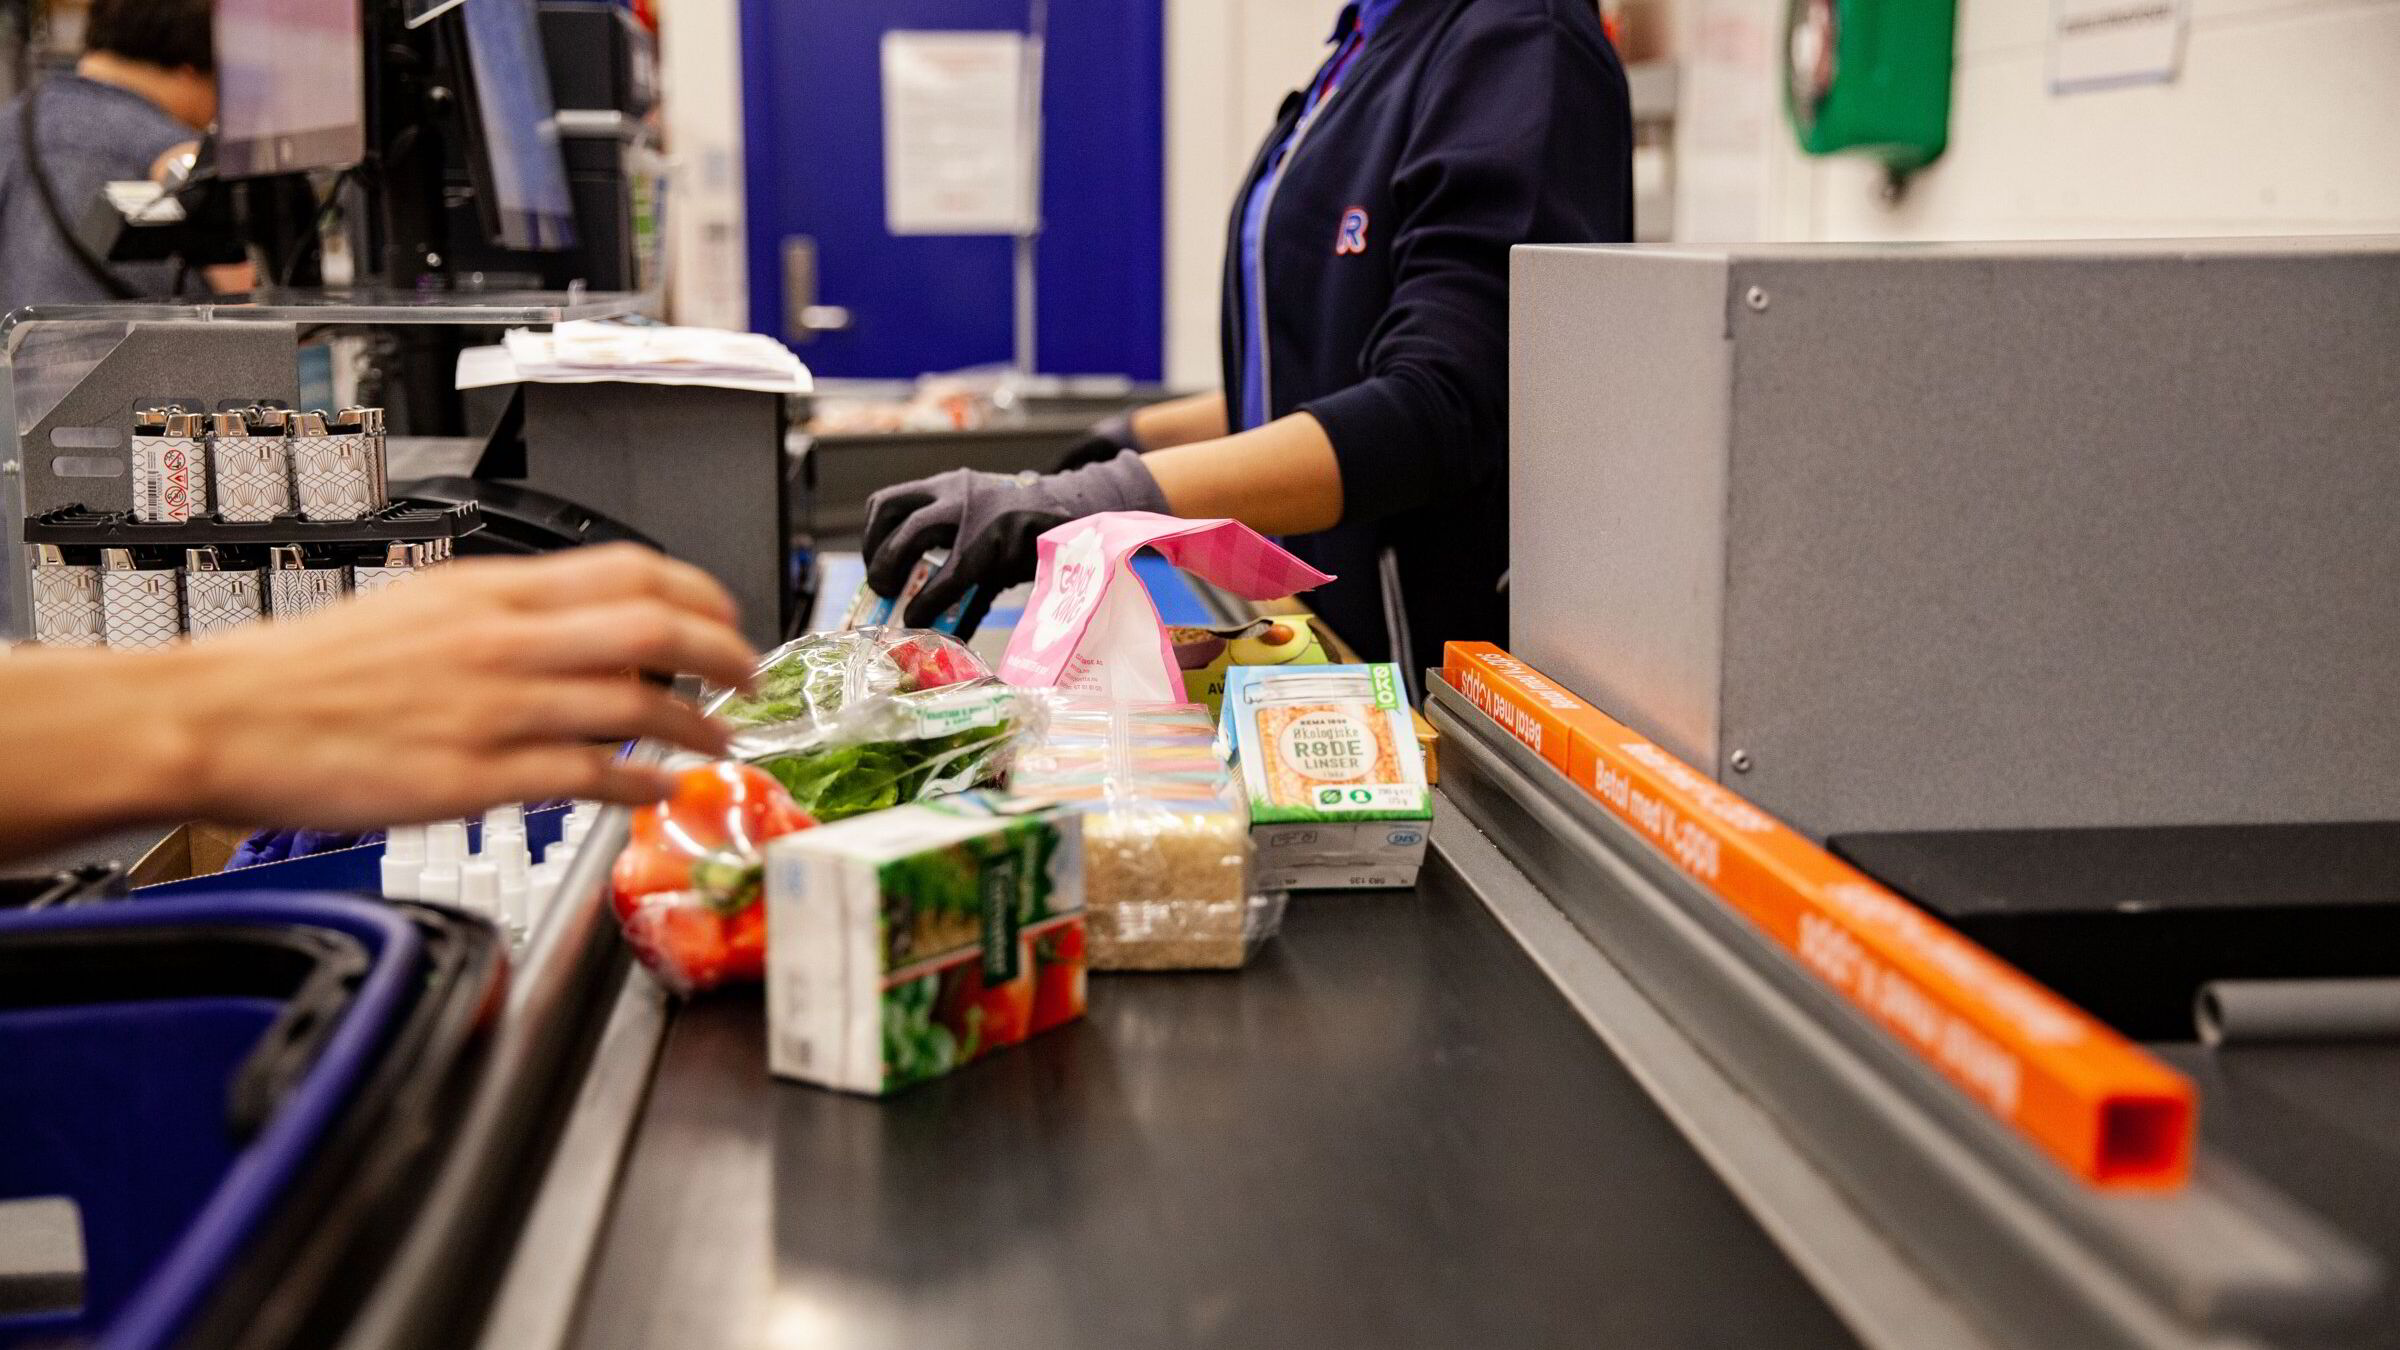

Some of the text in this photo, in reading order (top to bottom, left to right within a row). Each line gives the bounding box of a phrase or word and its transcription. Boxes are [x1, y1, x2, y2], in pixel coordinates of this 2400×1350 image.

[1336, 207, 1369, 255] R
[1494, 692, 1515, 728] med
[1516, 708, 1542, 752] Betal
[1294, 740, 1363, 757] RØDE
[1304, 758, 1359, 770] LINSER
